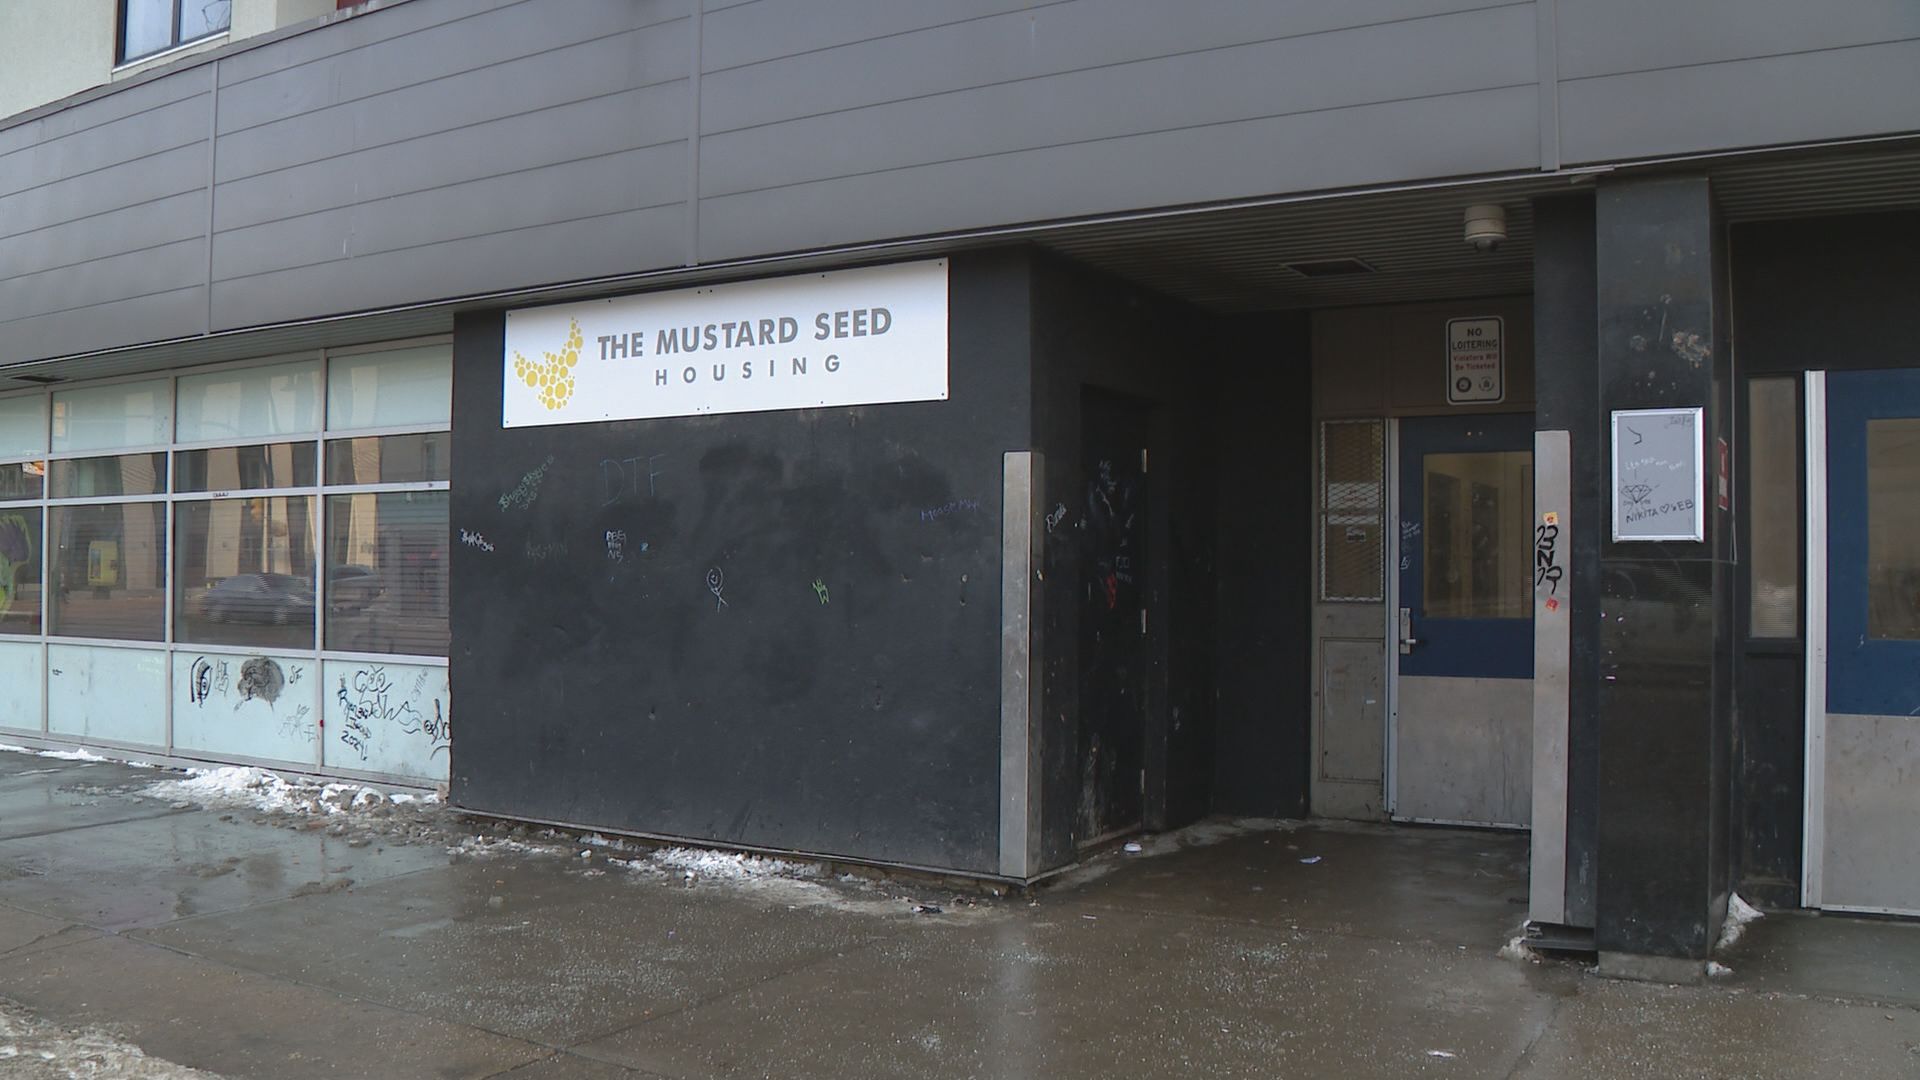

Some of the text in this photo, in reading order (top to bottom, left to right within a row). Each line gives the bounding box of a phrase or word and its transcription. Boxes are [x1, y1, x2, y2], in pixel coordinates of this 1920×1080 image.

[597, 307, 893, 361] THE MUSTARD SEED
[1467, 327, 1483, 337] NO
[1452, 339, 1498, 351] LOITERING
[655, 354, 841, 386] HOUSING
[1625, 507, 1659, 524] NIKITA
